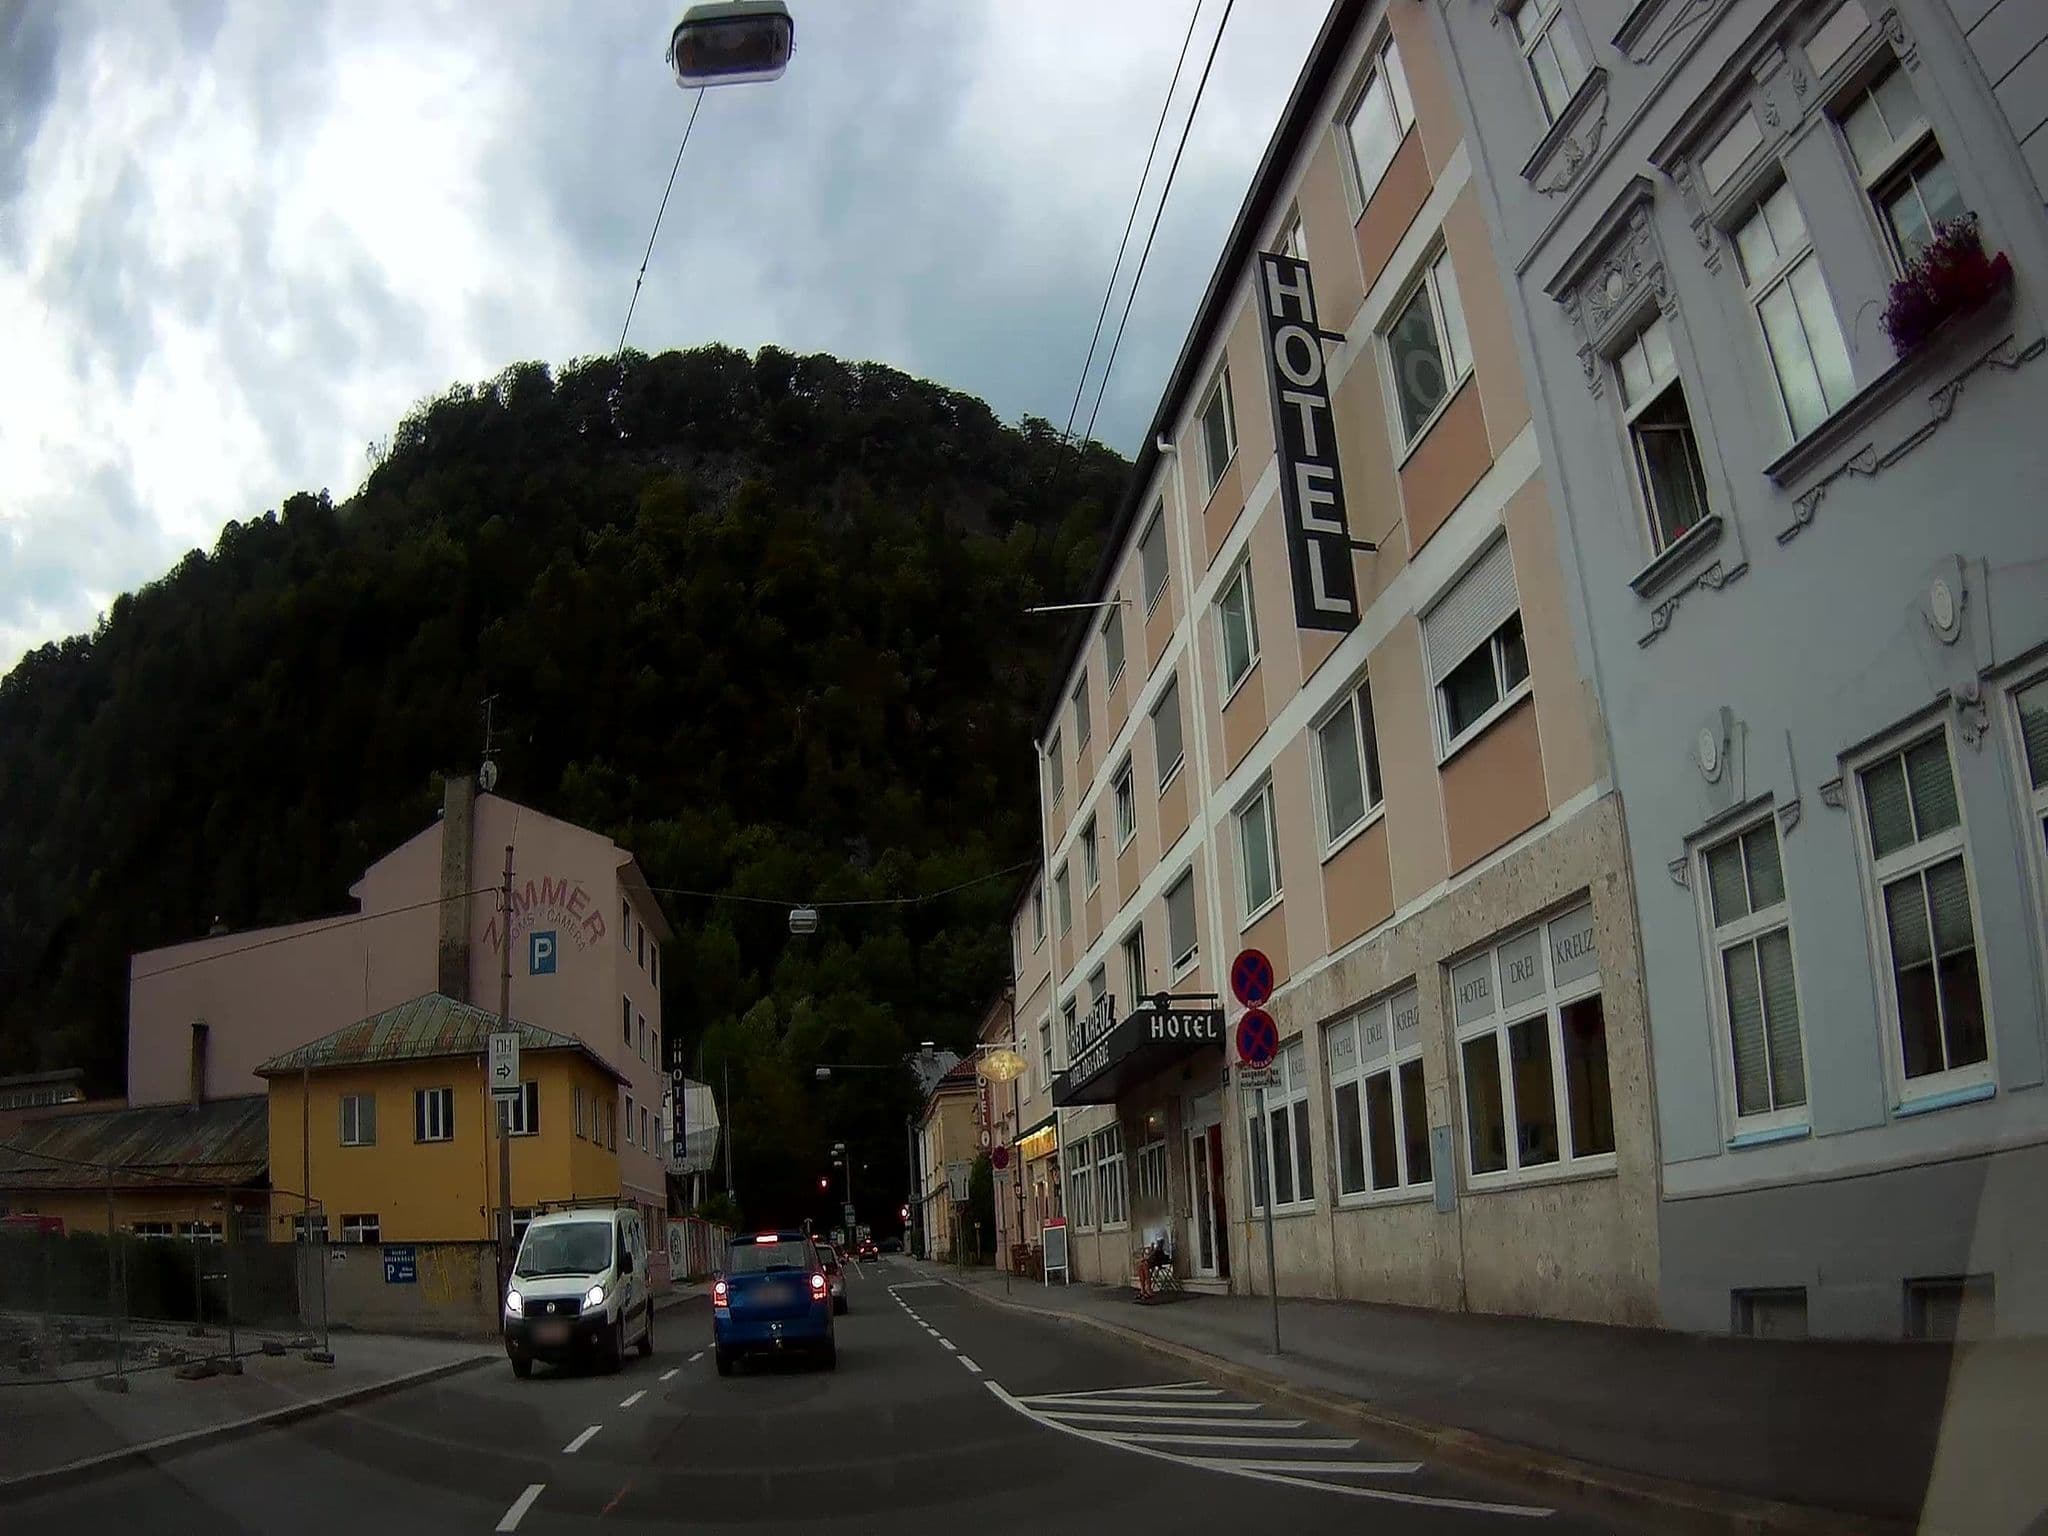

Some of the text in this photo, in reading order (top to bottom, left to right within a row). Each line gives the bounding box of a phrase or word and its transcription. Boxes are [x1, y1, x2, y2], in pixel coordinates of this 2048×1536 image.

[1265, 261, 1352, 614] HOTEL
[483, 875, 606, 955] ZMMER
[533, 937, 553, 970] P
[1458, 928, 1596, 1007] HOTEL DREI KREUZ
[1151, 1015, 1217, 1039] HOTEL
[977, 1076, 987, 1125] OTEL
